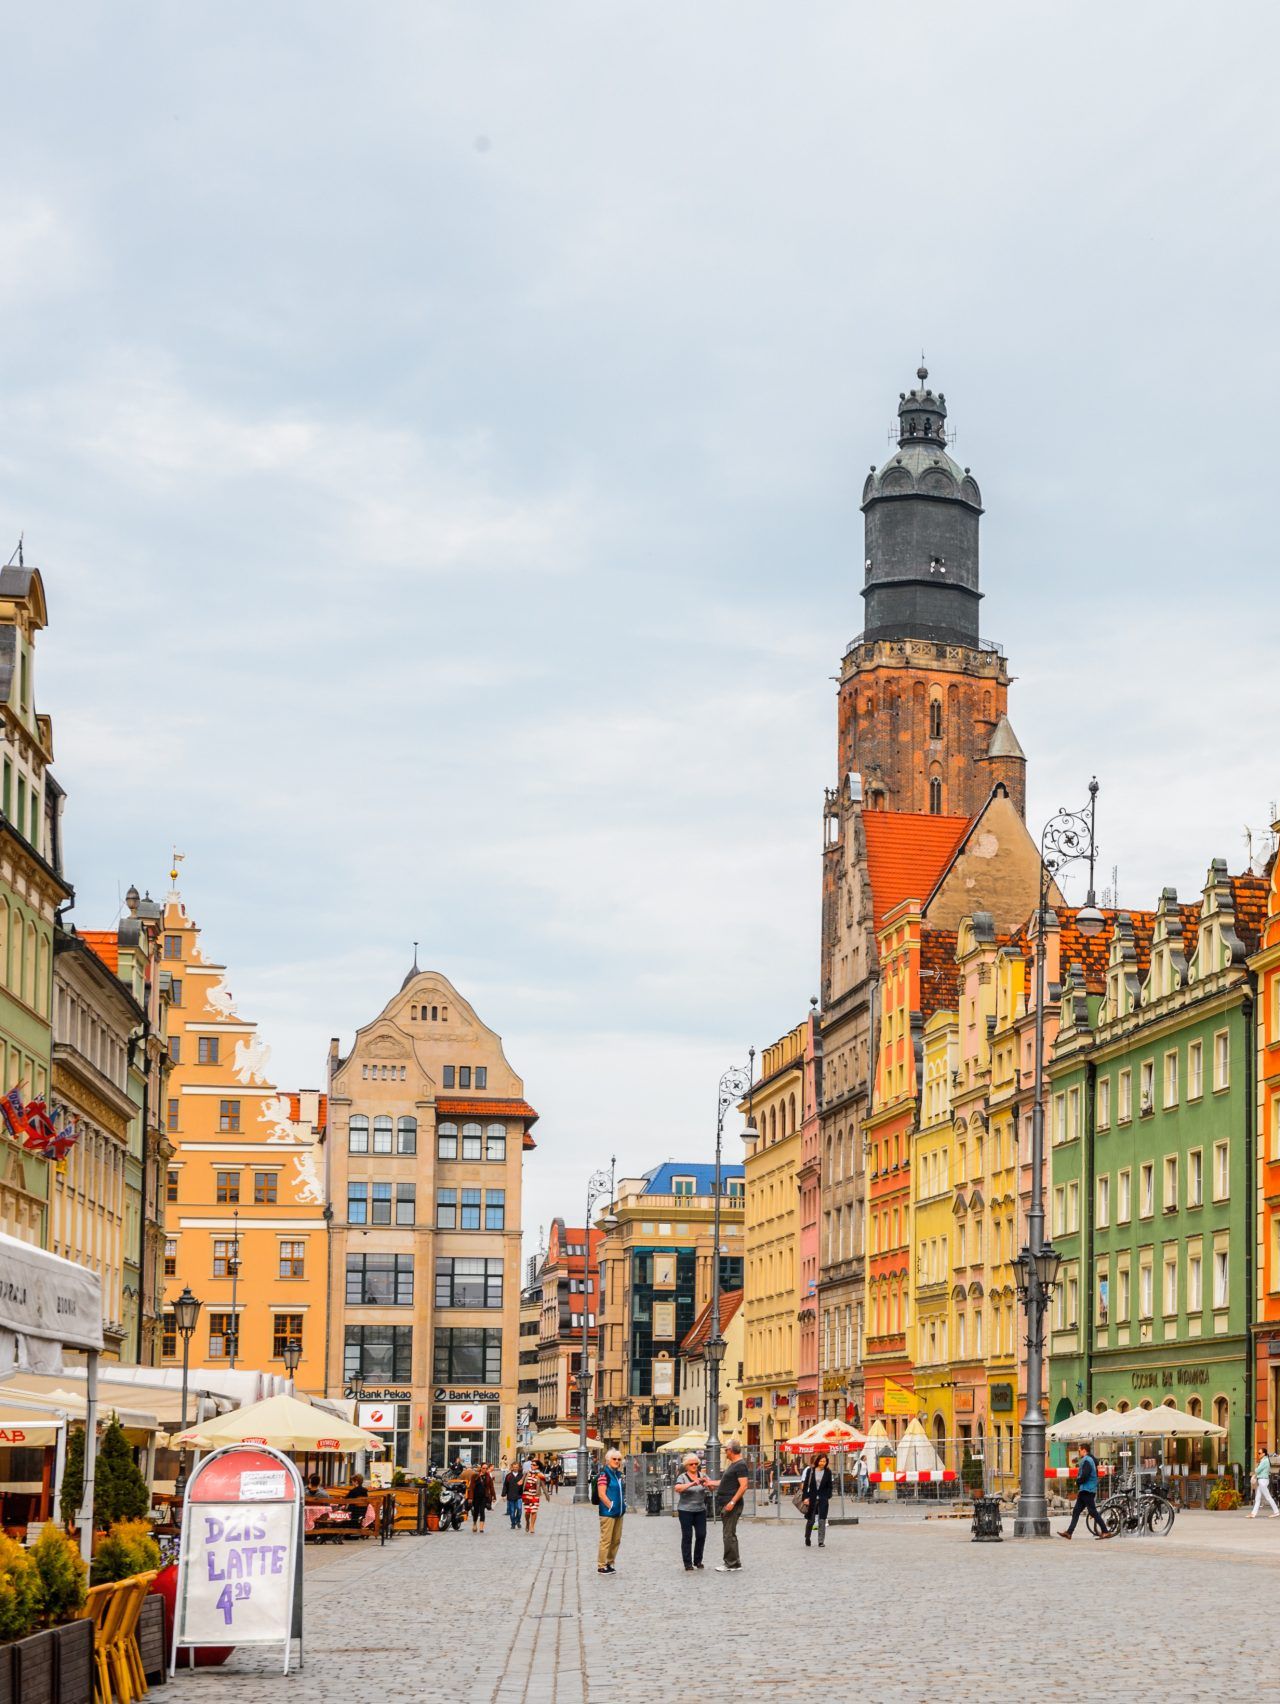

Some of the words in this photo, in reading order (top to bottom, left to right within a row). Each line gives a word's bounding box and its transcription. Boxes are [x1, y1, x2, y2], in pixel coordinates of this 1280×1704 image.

[359, 1389, 381, 1398] Bank
[383, 1389, 412, 1398] Pekao
[449, 1390, 471, 1400] Bank
[473, 1390, 500, 1400] Pekao
[207, 1546, 287, 1582] LATTE
